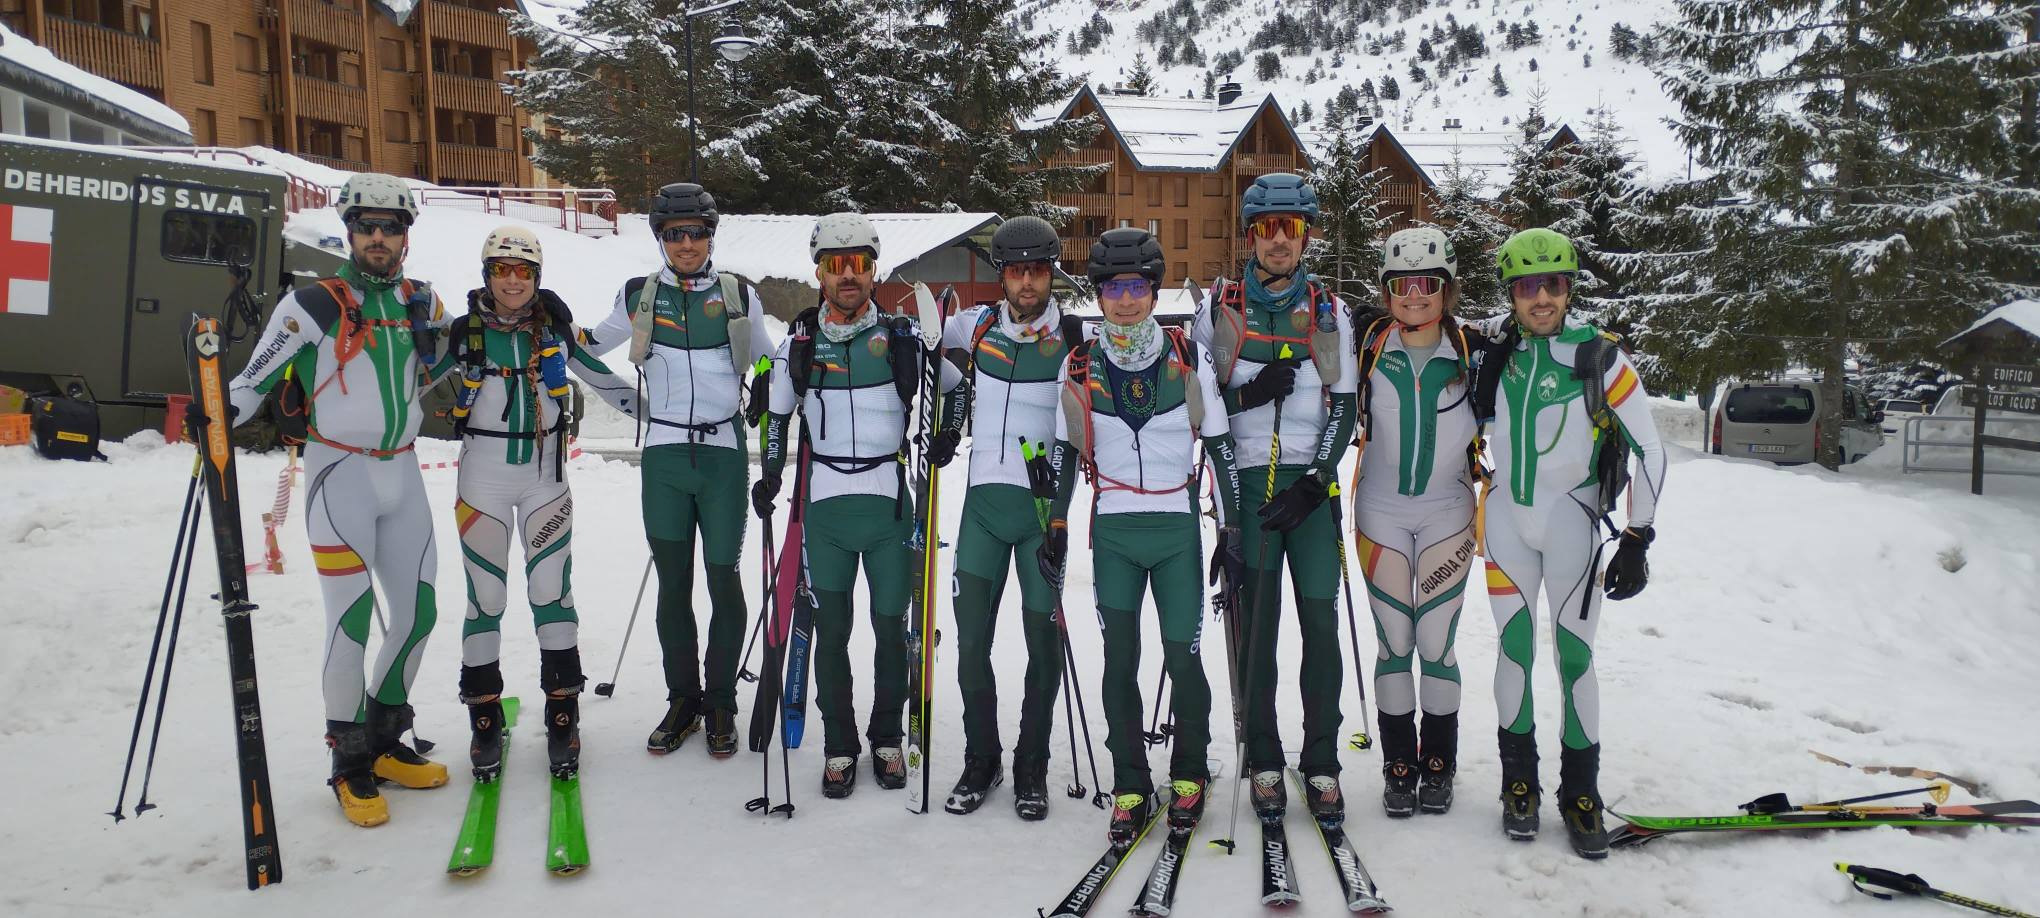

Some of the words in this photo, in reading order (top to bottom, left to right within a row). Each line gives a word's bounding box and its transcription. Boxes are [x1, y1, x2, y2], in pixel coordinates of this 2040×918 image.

[243, 348, 276, 380] GUARDIA
[1994, 367, 2033, 383] EDIFICIO
[203, 366, 226, 457] DYNASTAR
[920, 355, 935, 481] DYNAFIT
[1988, 394, 2005, 407] LOS
[2009, 396, 2036, 410] IGLOS
[1317, 420, 1341, 461] GUARDIA
[531, 514, 568, 549] GUARDIA
[1420, 559, 1462, 595] GUARDIA
[1455, 538, 1475, 562] CIVIL
[1066, 864, 1111, 912] DYNAFIT
[1149, 851, 1179, 902] DYNAFIT
[1333, 846, 1373, 898] DYNAFIT
